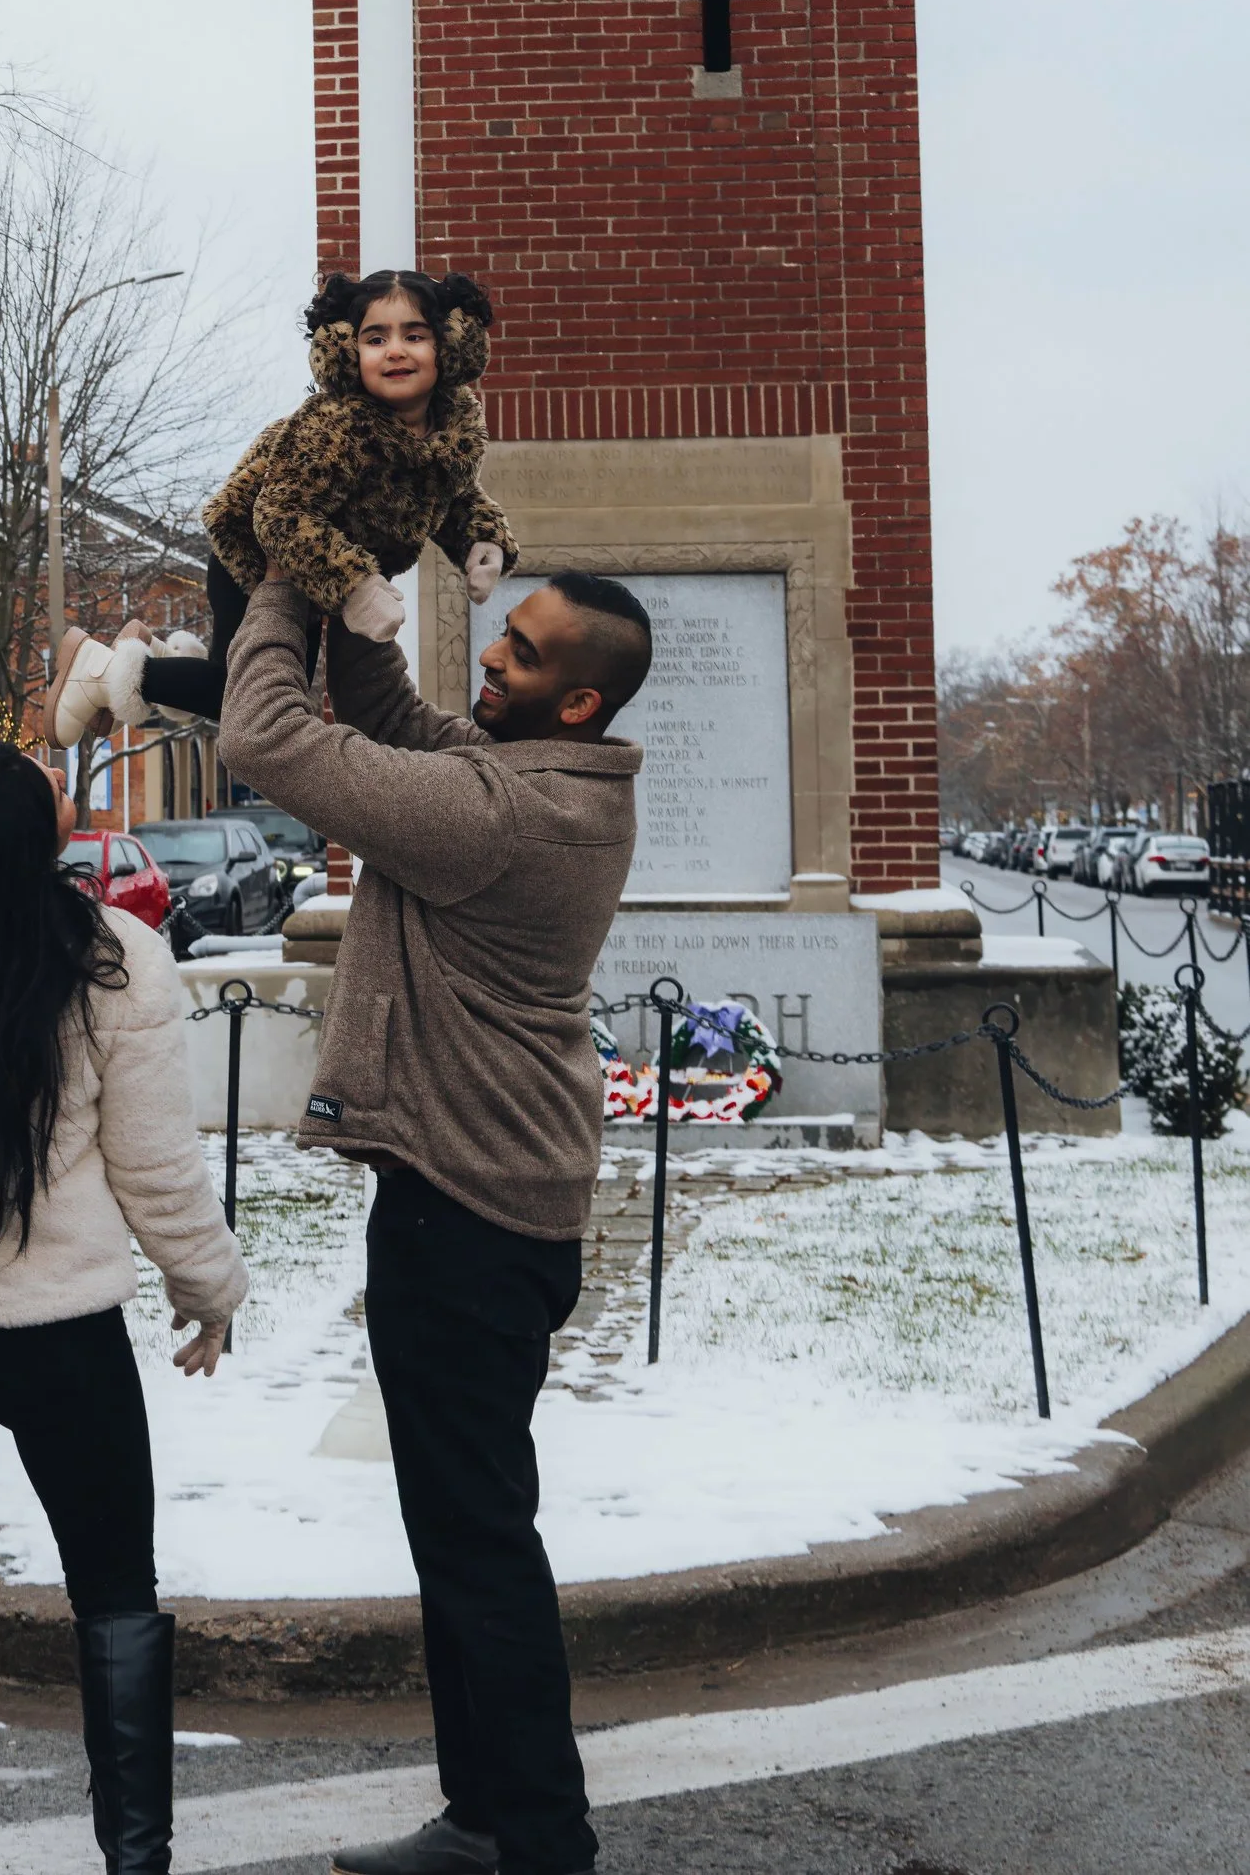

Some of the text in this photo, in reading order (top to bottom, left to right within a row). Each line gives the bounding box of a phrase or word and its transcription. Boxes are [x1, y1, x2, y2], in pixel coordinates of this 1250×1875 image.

[646, 597, 670, 611] 1918
[651, 618, 678, 630] SBET,
[653, 633, 671, 645] AN,
[676, 633, 716, 644] GORDON
[654, 646, 695, 659] EPHERD,
[700, 646, 732, 658] EDWIN
[651, 661, 686, 673] HOMAS,
[702, 675, 748, 687] CHARLES
[647, 699, 675, 713] 1945
[633, 859, 655, 872] REA
[604, 935, 840, 950] AIR THEY LAID DOWN THEIR LIVES
[614, 960, 679, 975] FREEDOM
